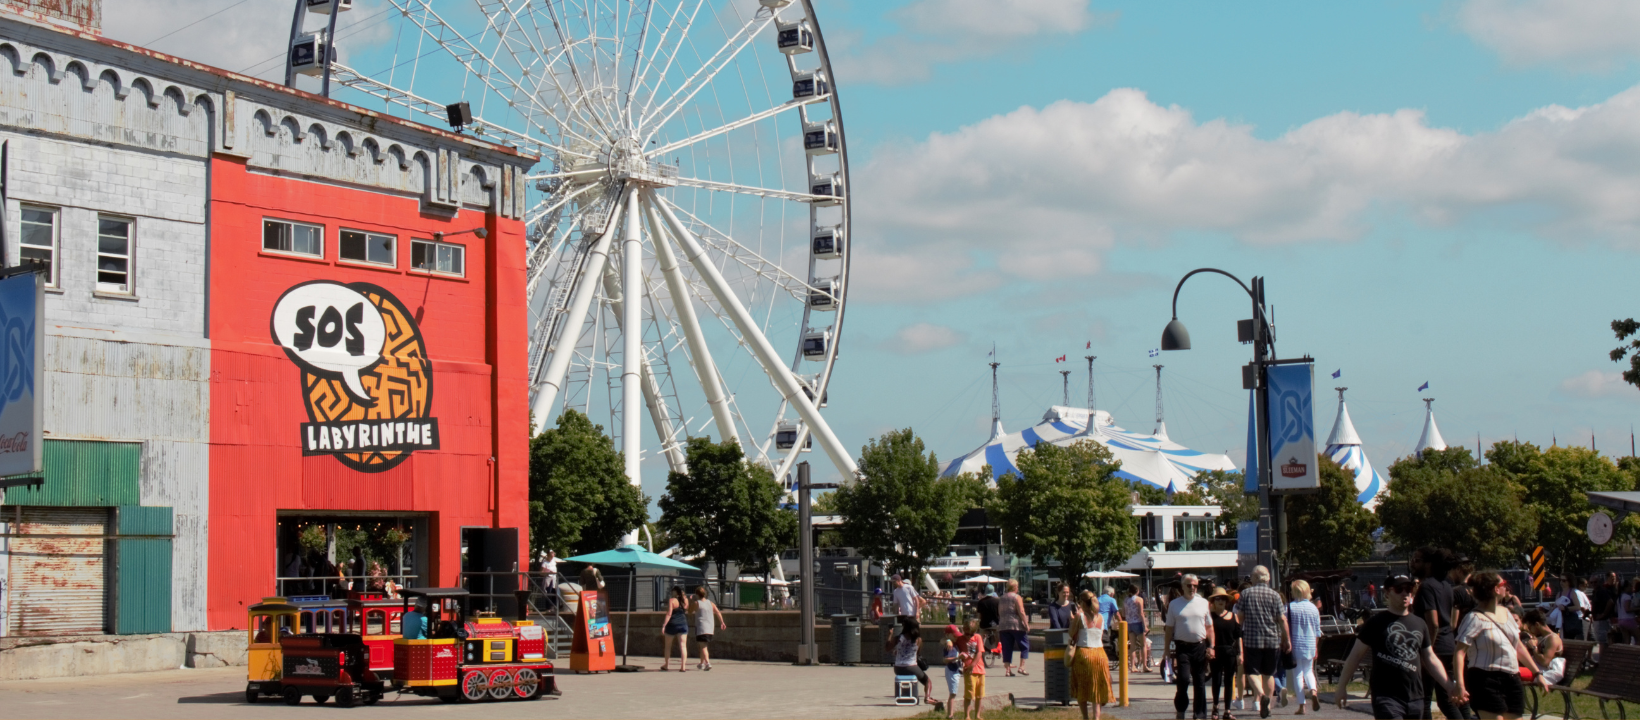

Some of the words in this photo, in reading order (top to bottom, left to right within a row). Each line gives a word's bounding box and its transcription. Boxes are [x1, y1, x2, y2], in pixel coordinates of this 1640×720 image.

[293, 302, 365, 356] SOS
[307, 422, 432, 451] LABYRINTHE
[1282, 466, 1305, 474] SLEEMAN
[1376, 651, 1417, 672] RADIOHEAD
